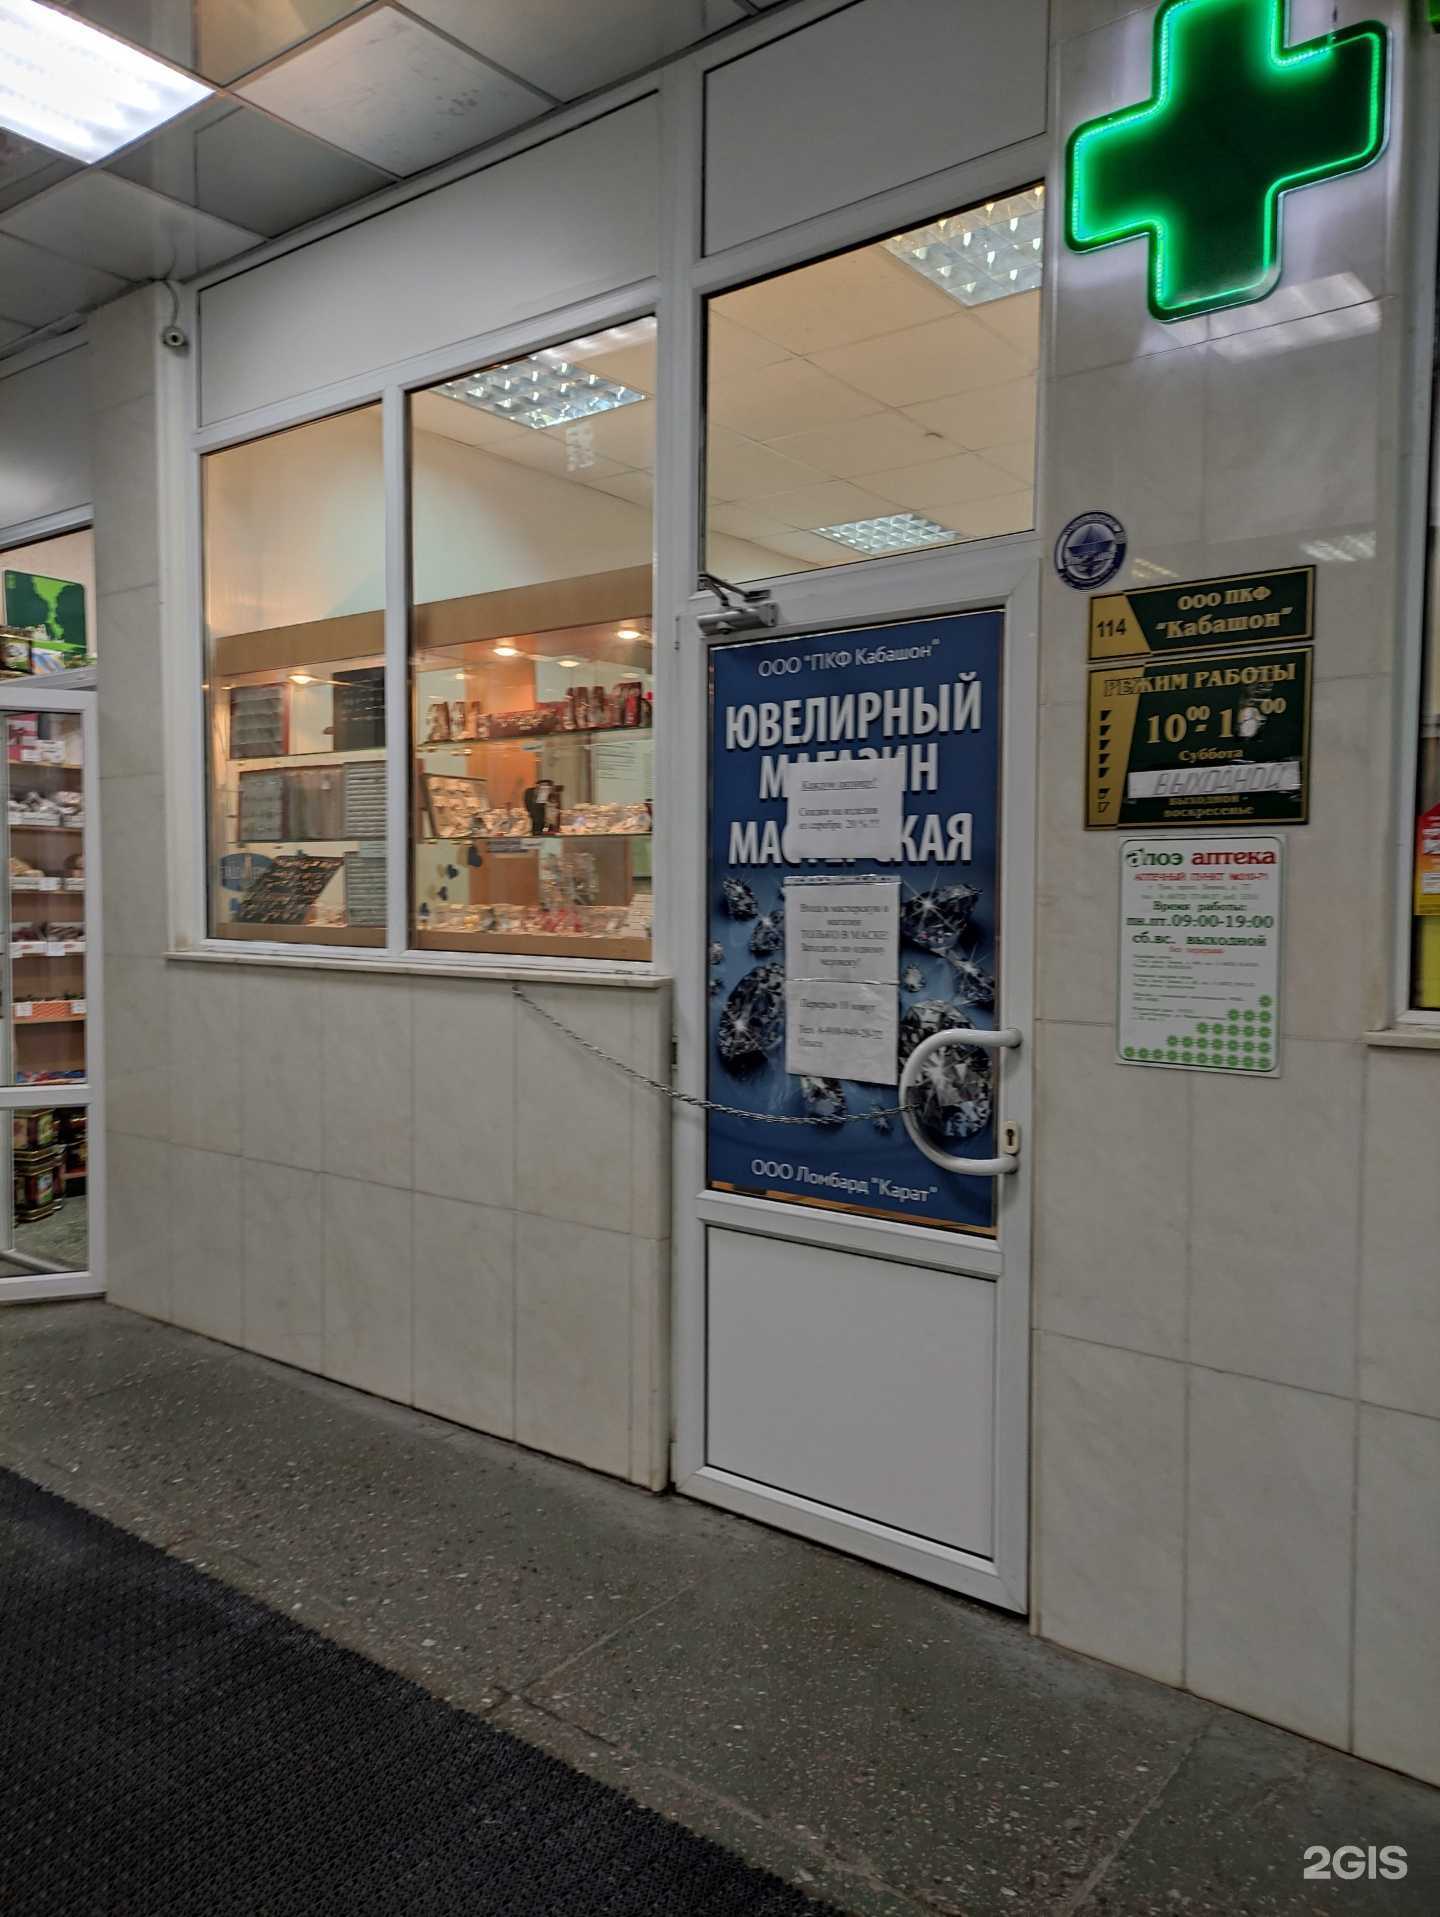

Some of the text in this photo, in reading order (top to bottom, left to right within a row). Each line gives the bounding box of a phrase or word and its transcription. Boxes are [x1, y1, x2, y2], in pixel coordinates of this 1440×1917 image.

[1177, 586, 1272, 610] ООО ПКФ
[1097, 619, 1126, 638] 114
[758, 656, 801, 677] ООО
[1103, 663, 1296, 696] РЕЖИМ РАБОТЫ
[726, 672, 982, 750] ЮВЕЛИРНЫЙ
[1179, 748, 1244, 763] Суббота
[1192, 850, 1276, 865] аптека
[751, 1159, 794, 1180] ООО
[795, 1166, 870, 1195] Ломбард
